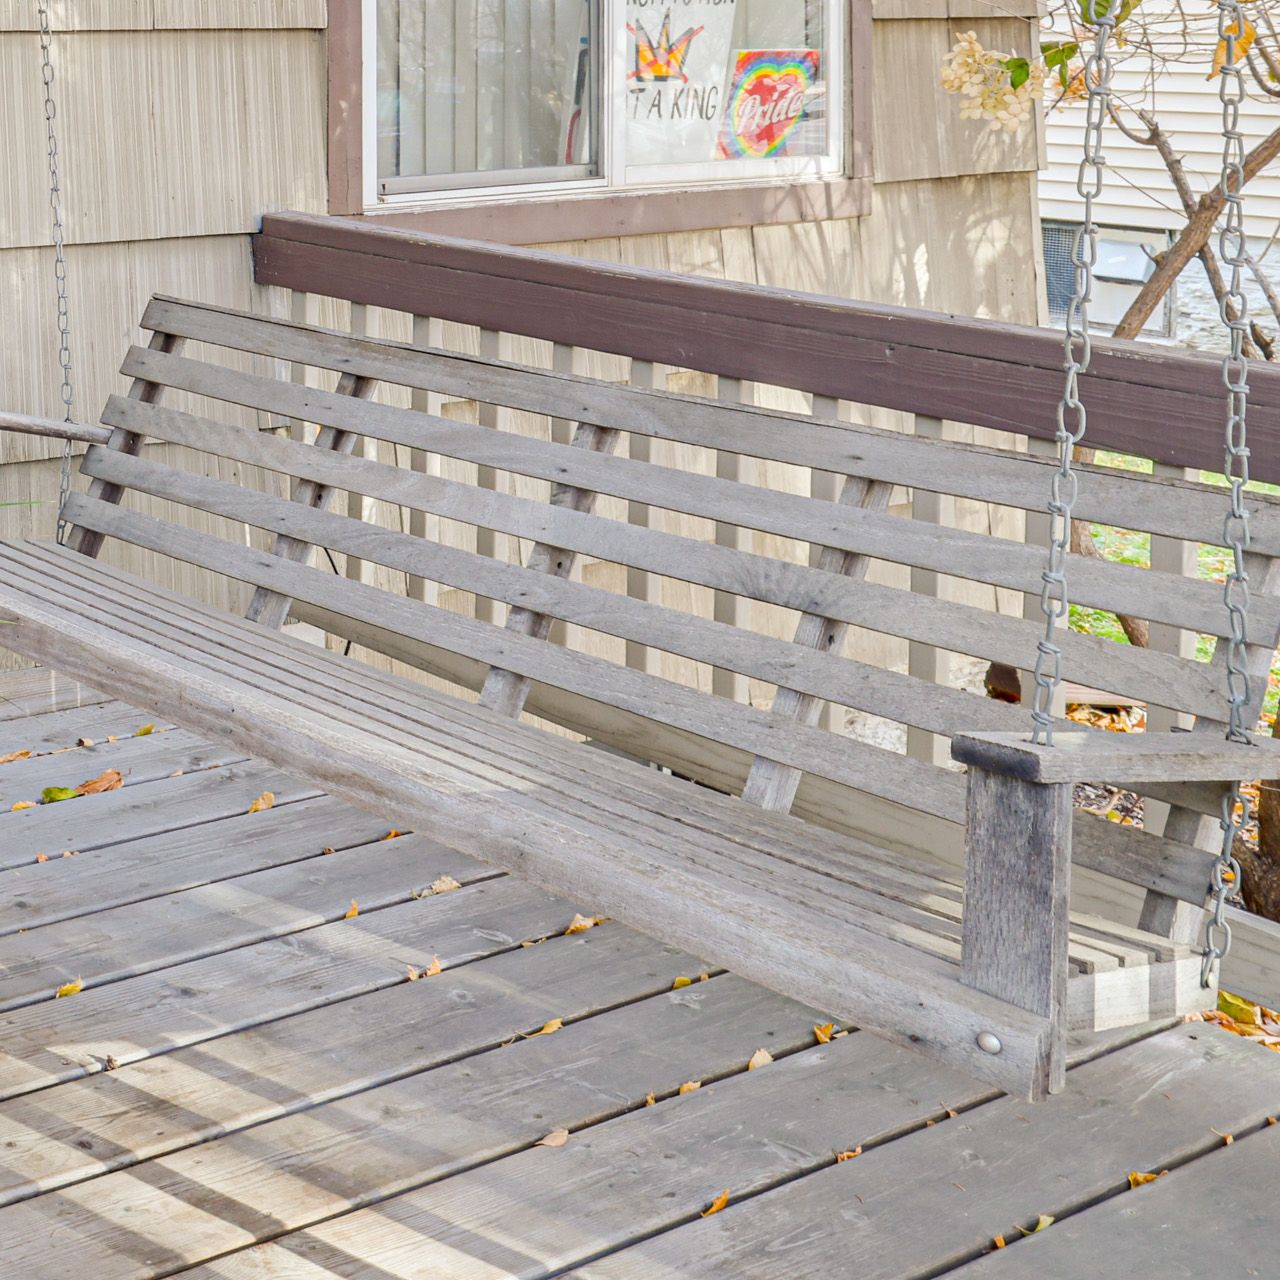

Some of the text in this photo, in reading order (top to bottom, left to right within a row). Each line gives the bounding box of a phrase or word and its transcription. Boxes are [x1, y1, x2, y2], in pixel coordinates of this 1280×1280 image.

[626, 86, 718, 121] T A KING
[736, 85, 804, 136] Pride
